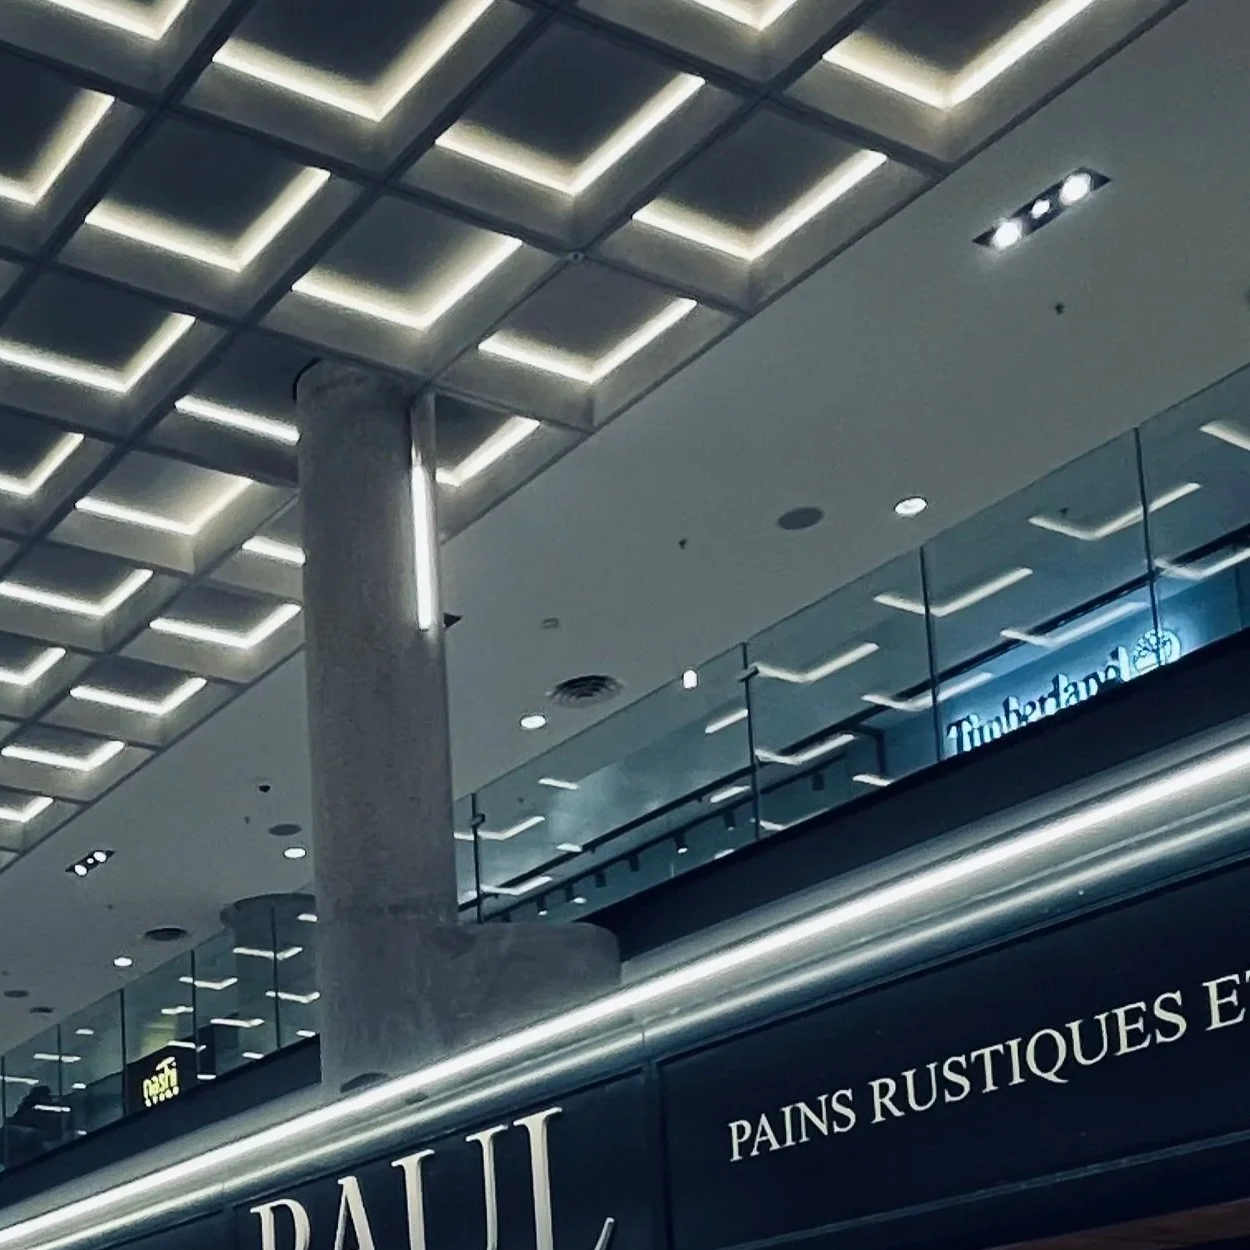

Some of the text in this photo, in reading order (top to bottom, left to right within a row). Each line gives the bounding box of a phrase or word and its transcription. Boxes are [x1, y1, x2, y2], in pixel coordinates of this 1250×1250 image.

[946, 646, 1130, 757] Timberland
[727, 1088, 857, 1162] PAINS
[868, 991, 1188, 1125] RUSTIQUES
